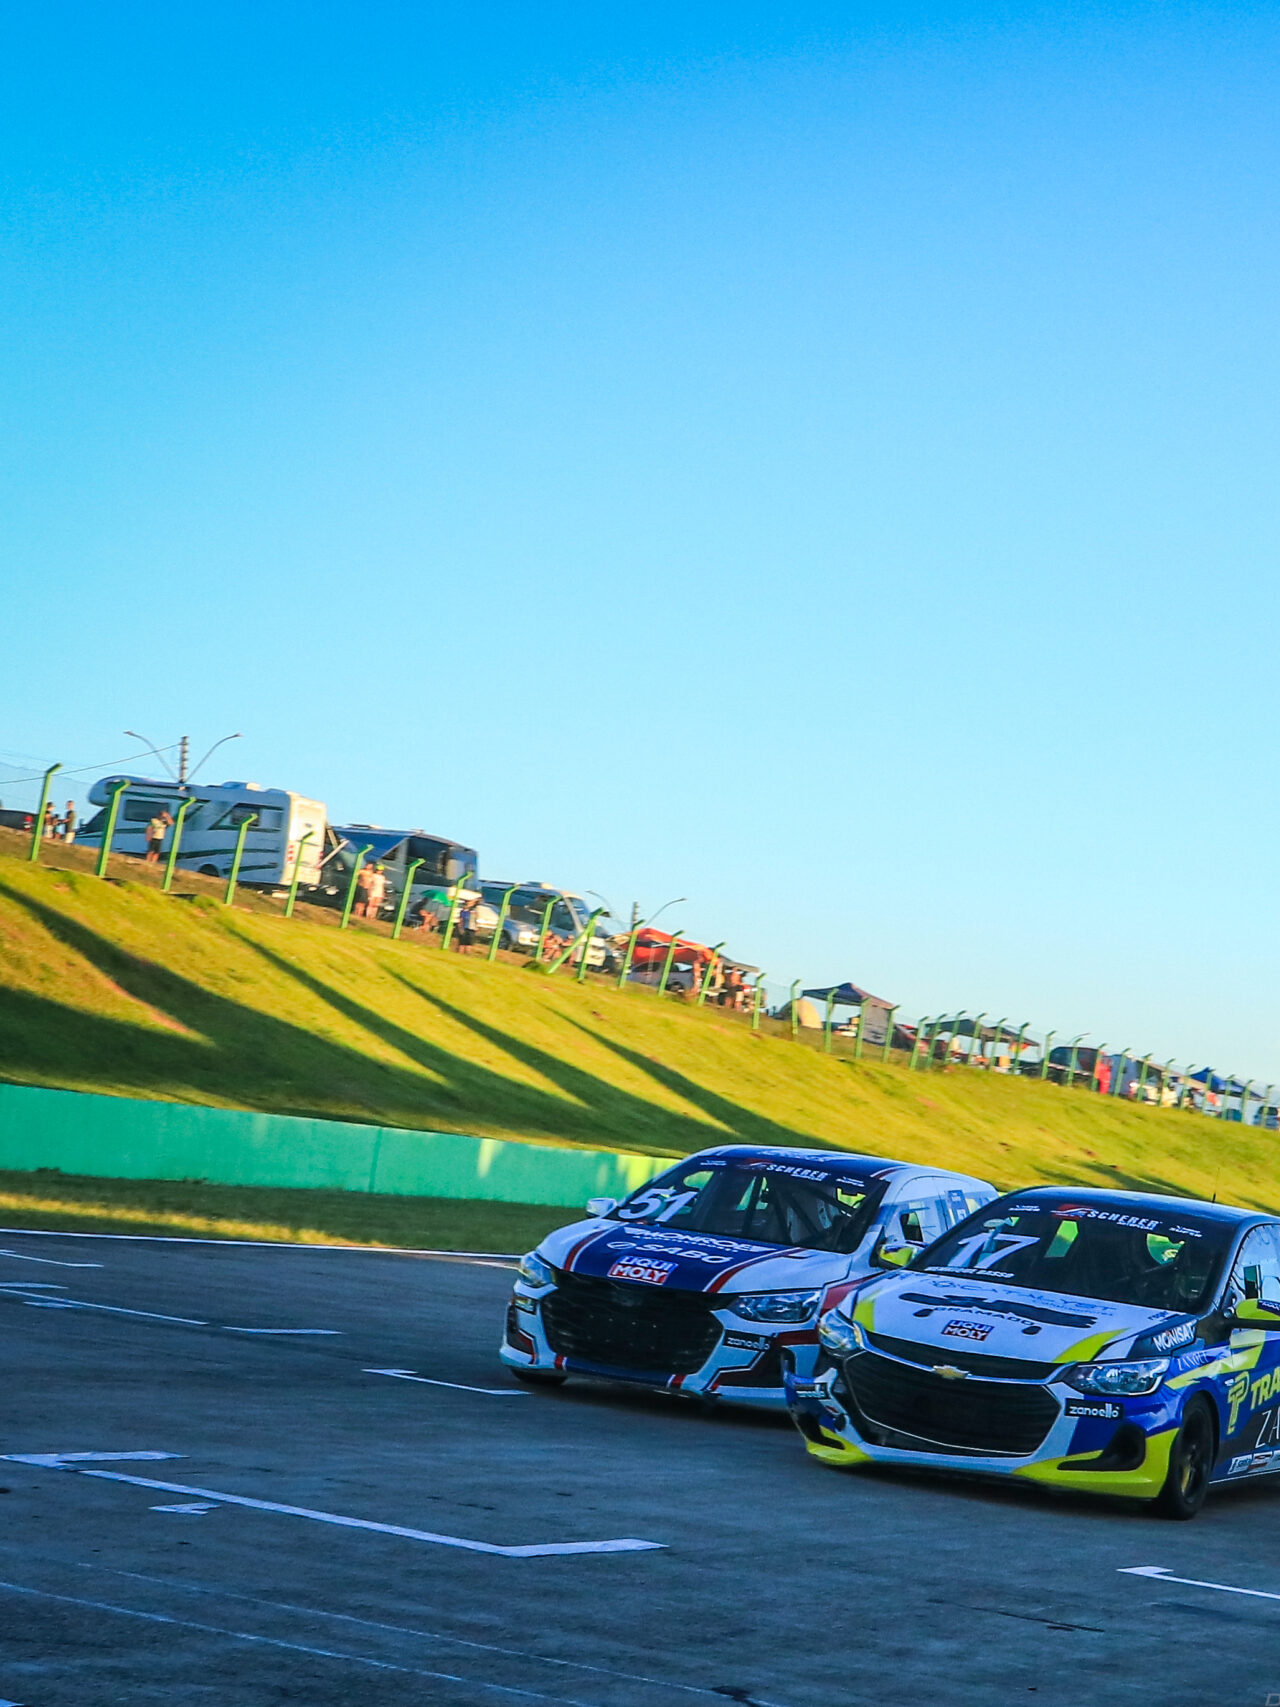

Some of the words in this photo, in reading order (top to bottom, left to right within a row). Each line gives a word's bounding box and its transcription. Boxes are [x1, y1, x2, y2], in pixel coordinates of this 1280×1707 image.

[766, 1163, 830, 1180] SCHERER
[618, 1187, 698, 1223] 51
[1087, 1208, 1160, 1229] SCHERER
[947, 1232, 1041, 1270] 17
[618, 1256, 675, 1271] LIQUI
[611, 1265, 668, 1283] MOLY
[943, 1326, 988, 1340] MOLY
[949, 1319, 994, 1332] LIQUI
[1152, 1319, 1198, 1352] MONISAT
[1069, 1402, 1119, 1419] zanoello
